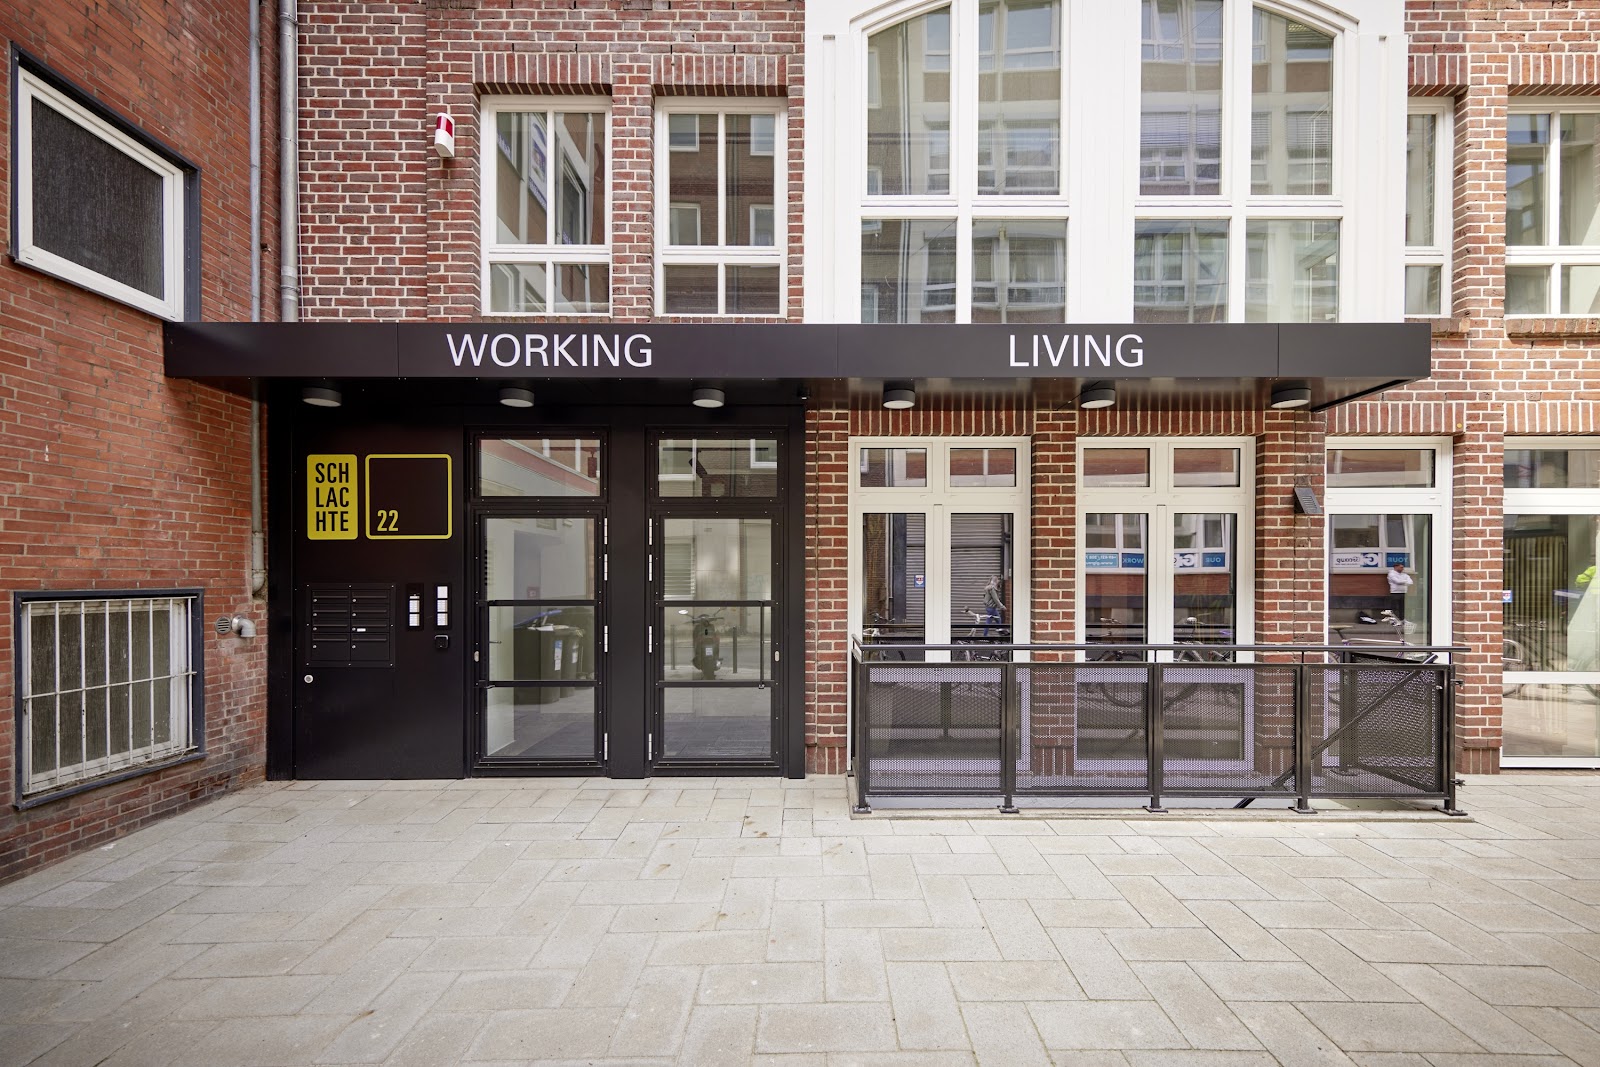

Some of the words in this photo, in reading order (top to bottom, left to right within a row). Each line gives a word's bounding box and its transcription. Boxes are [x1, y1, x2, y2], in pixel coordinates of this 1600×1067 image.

[446, 333, 652, 369] WORKING
[1009, 333, 1144, 369] LIVING
[315, 462, 349, 484] SCH
[315, 486, 349, 508] LAC
[315, 510, 349, 532] HTE
[377, 509, 399, 532] 22
